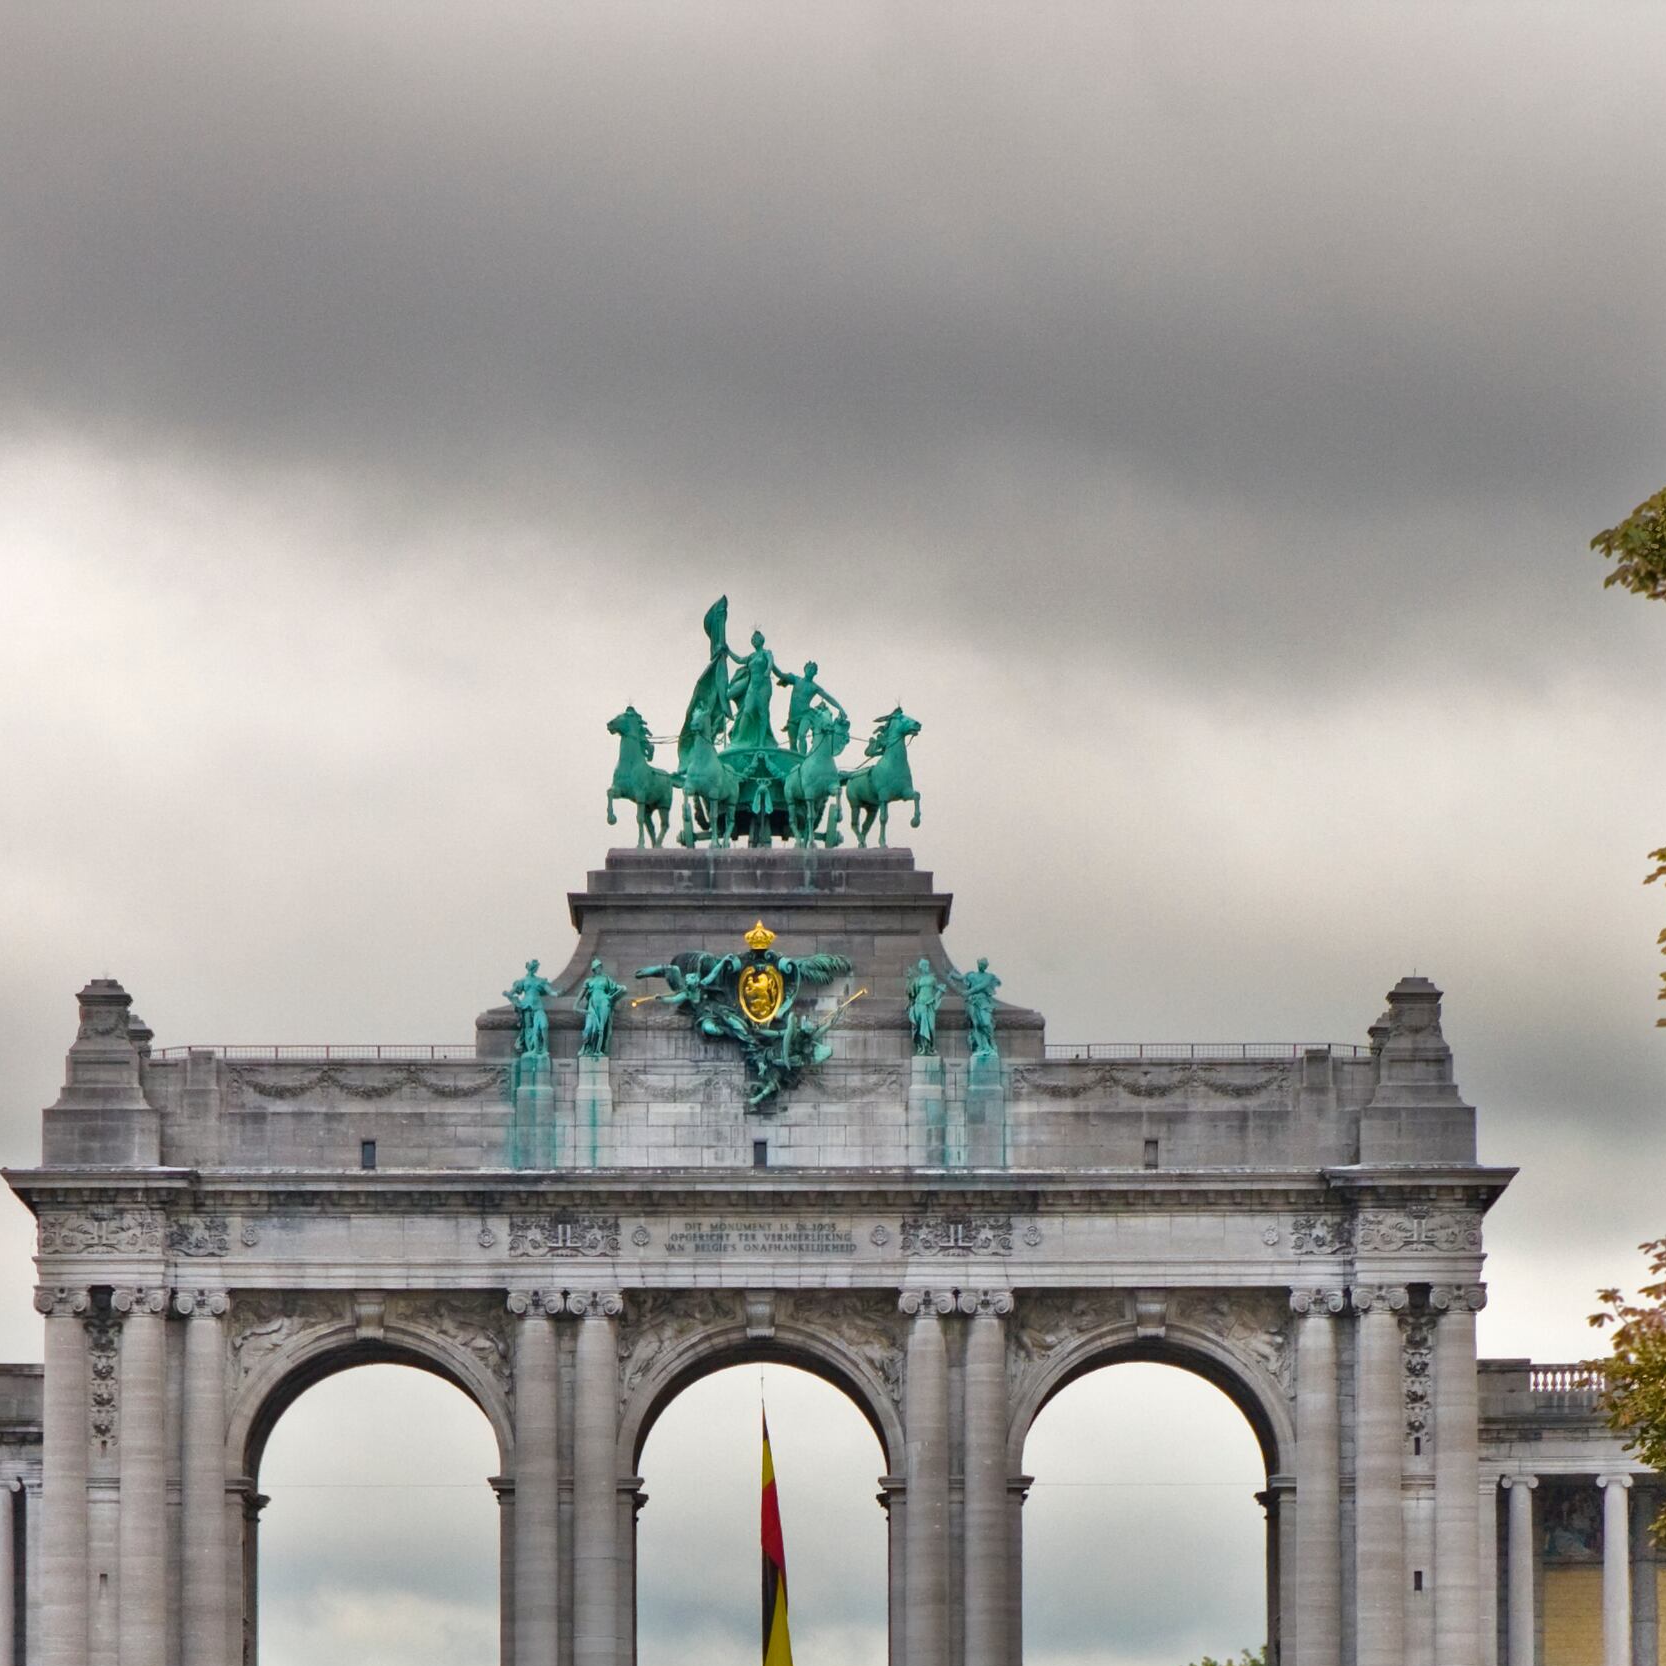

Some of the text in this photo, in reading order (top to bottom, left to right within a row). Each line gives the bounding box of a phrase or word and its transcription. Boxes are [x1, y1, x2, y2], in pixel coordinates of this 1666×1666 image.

[684, 1222, 702, 1232] DIT
[710, 1222, 772, 1232] MONUMENT
[780, 1222, 790, 1232] IS
[670, 1232, 730, 1242] OPGERICHT
[739, 1232, 757, 1242] TER
[664, 1243, 685, 1253] VAN
